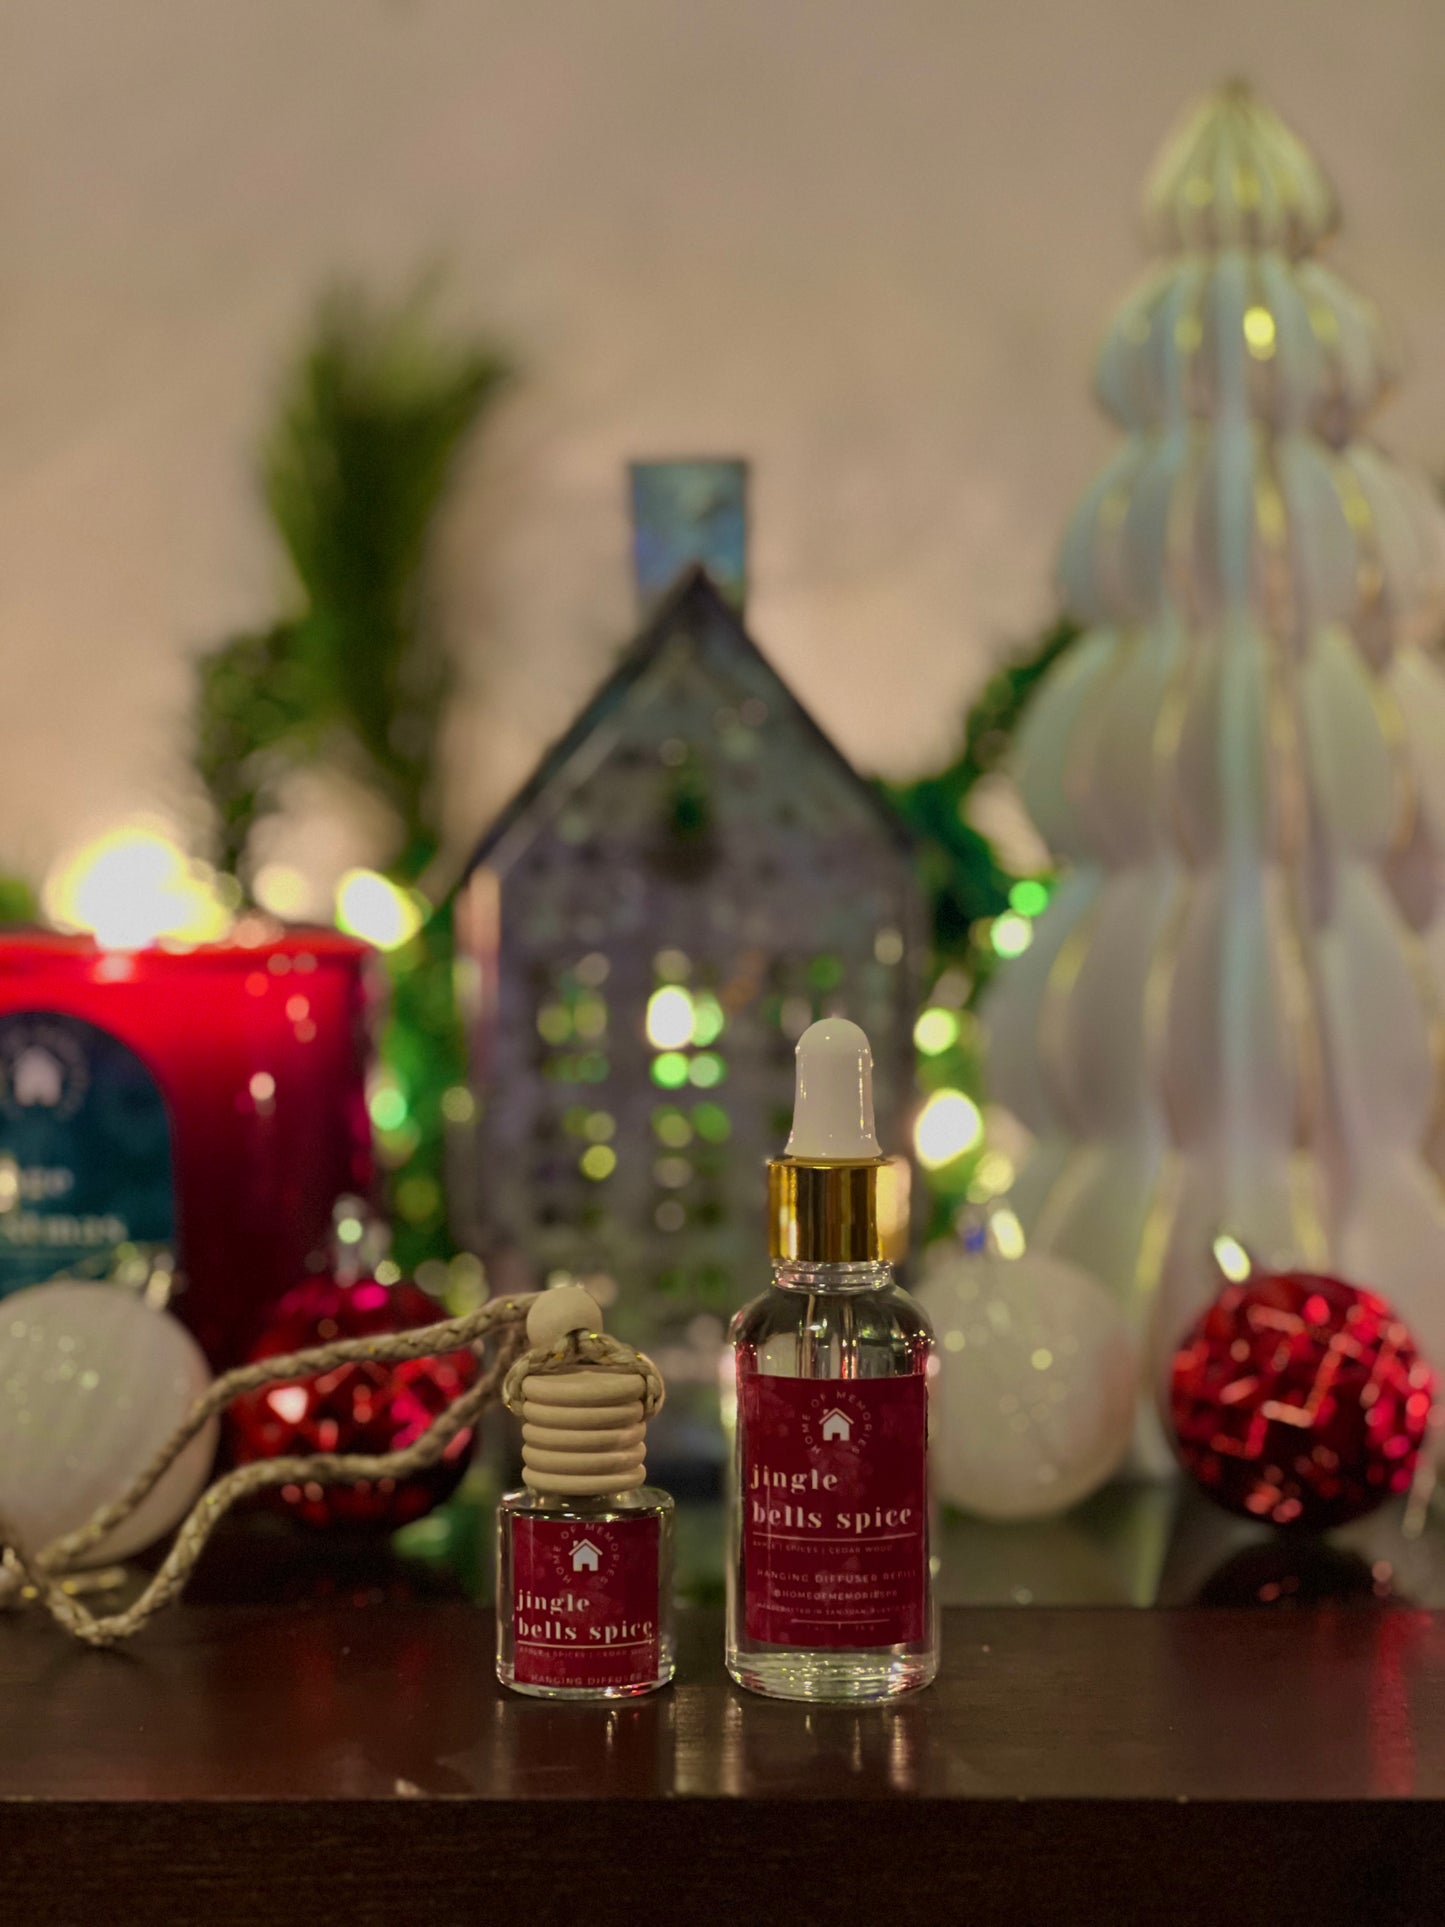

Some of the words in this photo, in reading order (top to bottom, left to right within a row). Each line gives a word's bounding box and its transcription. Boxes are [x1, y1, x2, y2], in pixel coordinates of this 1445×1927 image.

[811, 1392, 827, 1408] OF
[802, 1413, 822, 1456] HOME
[836, 1389, 873, 1455] MEMORIES
[750, 1464, 838, 1494] jingle
[560, 1525, 577, 1540] OF
[753, 1501, 822, 1529] bells
[836, 1506, 912, 1534] spice
[552, 1544, 573, 1584] HOME
[584, 1523, 621, 1585] MEMORIES
[757, 1569, 809, 1583] HANGING
[814, 1573, 878, 1584] DIFFUSER
[516, 1588, 591, 1616] jingle
[518, 1616, 577, 1641] bells
[589, 1620, 654, 1645] spice
